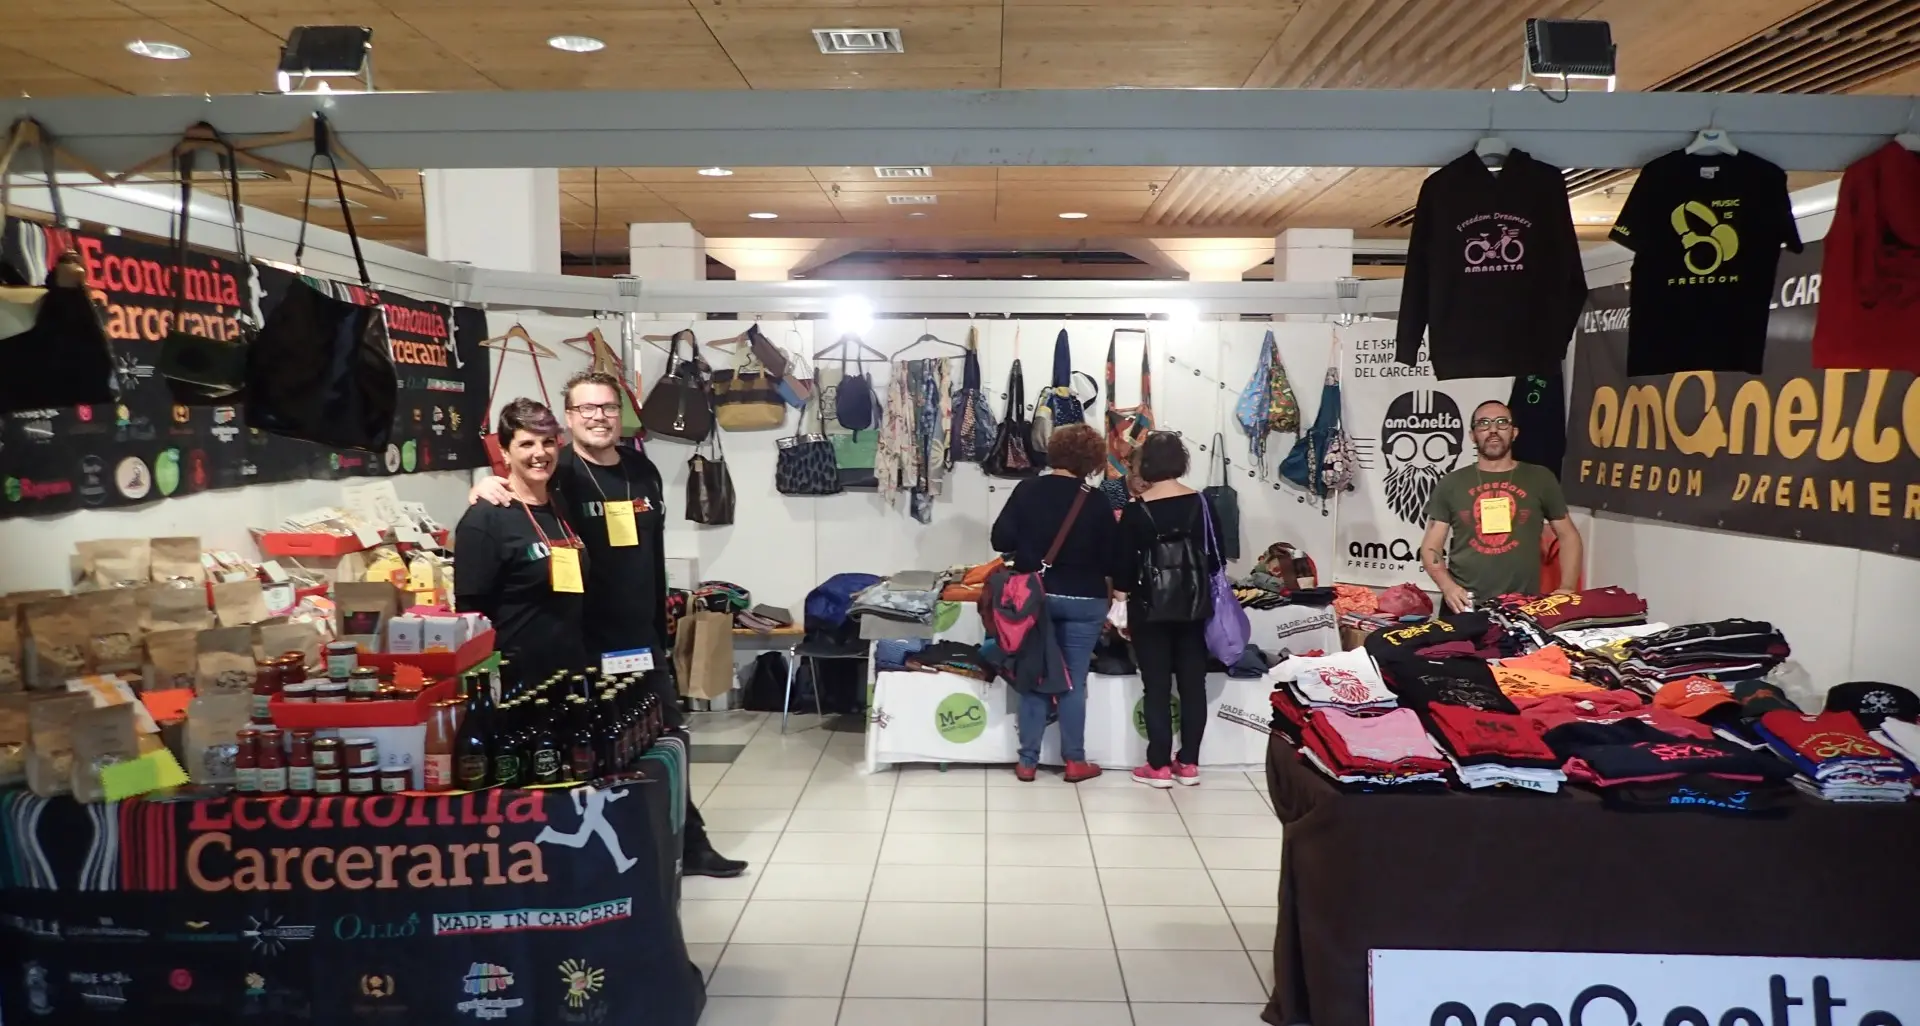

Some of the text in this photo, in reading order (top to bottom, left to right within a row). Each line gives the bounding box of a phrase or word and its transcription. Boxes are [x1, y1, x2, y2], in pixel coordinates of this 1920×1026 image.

[1711, 199, 1740, 208] MUSIC
[1456, 212, 1533, 233] Freedom Dreamers
[1723, 211, 1733, 219] IS
[1667, 275, 1739, 286] FREEDOM
[1780, 274, 1822, 308] CAR
[375, 294, 448, 338] conomia
[1594, 307, 1631, 331] T-SHIR
[391, 338, 448, 367] rceraria
[1356, 339, 1396, 351] LE T-SH
[1355, 352, 1394, 364] STAMP
[1355, 366, 1430, 378] DEL CARCERE
[1579, 459, 1702, 497] FREEDOM
[1468, 481, 1528, 499] Freedom
[1348, 560, 1404, 571] FREEDOM
[1276, 620, 1300, 632] MADE
[1307, 613, 1335, 624] CARCE
[1220, 703, 1244, 716] MADE
[186, 825, 549, 891] Carceraria
[437, 914, 492, 931] MADE
[504, 911, 529, 928] IN
[538, 901, 627, 927] CARCERE
